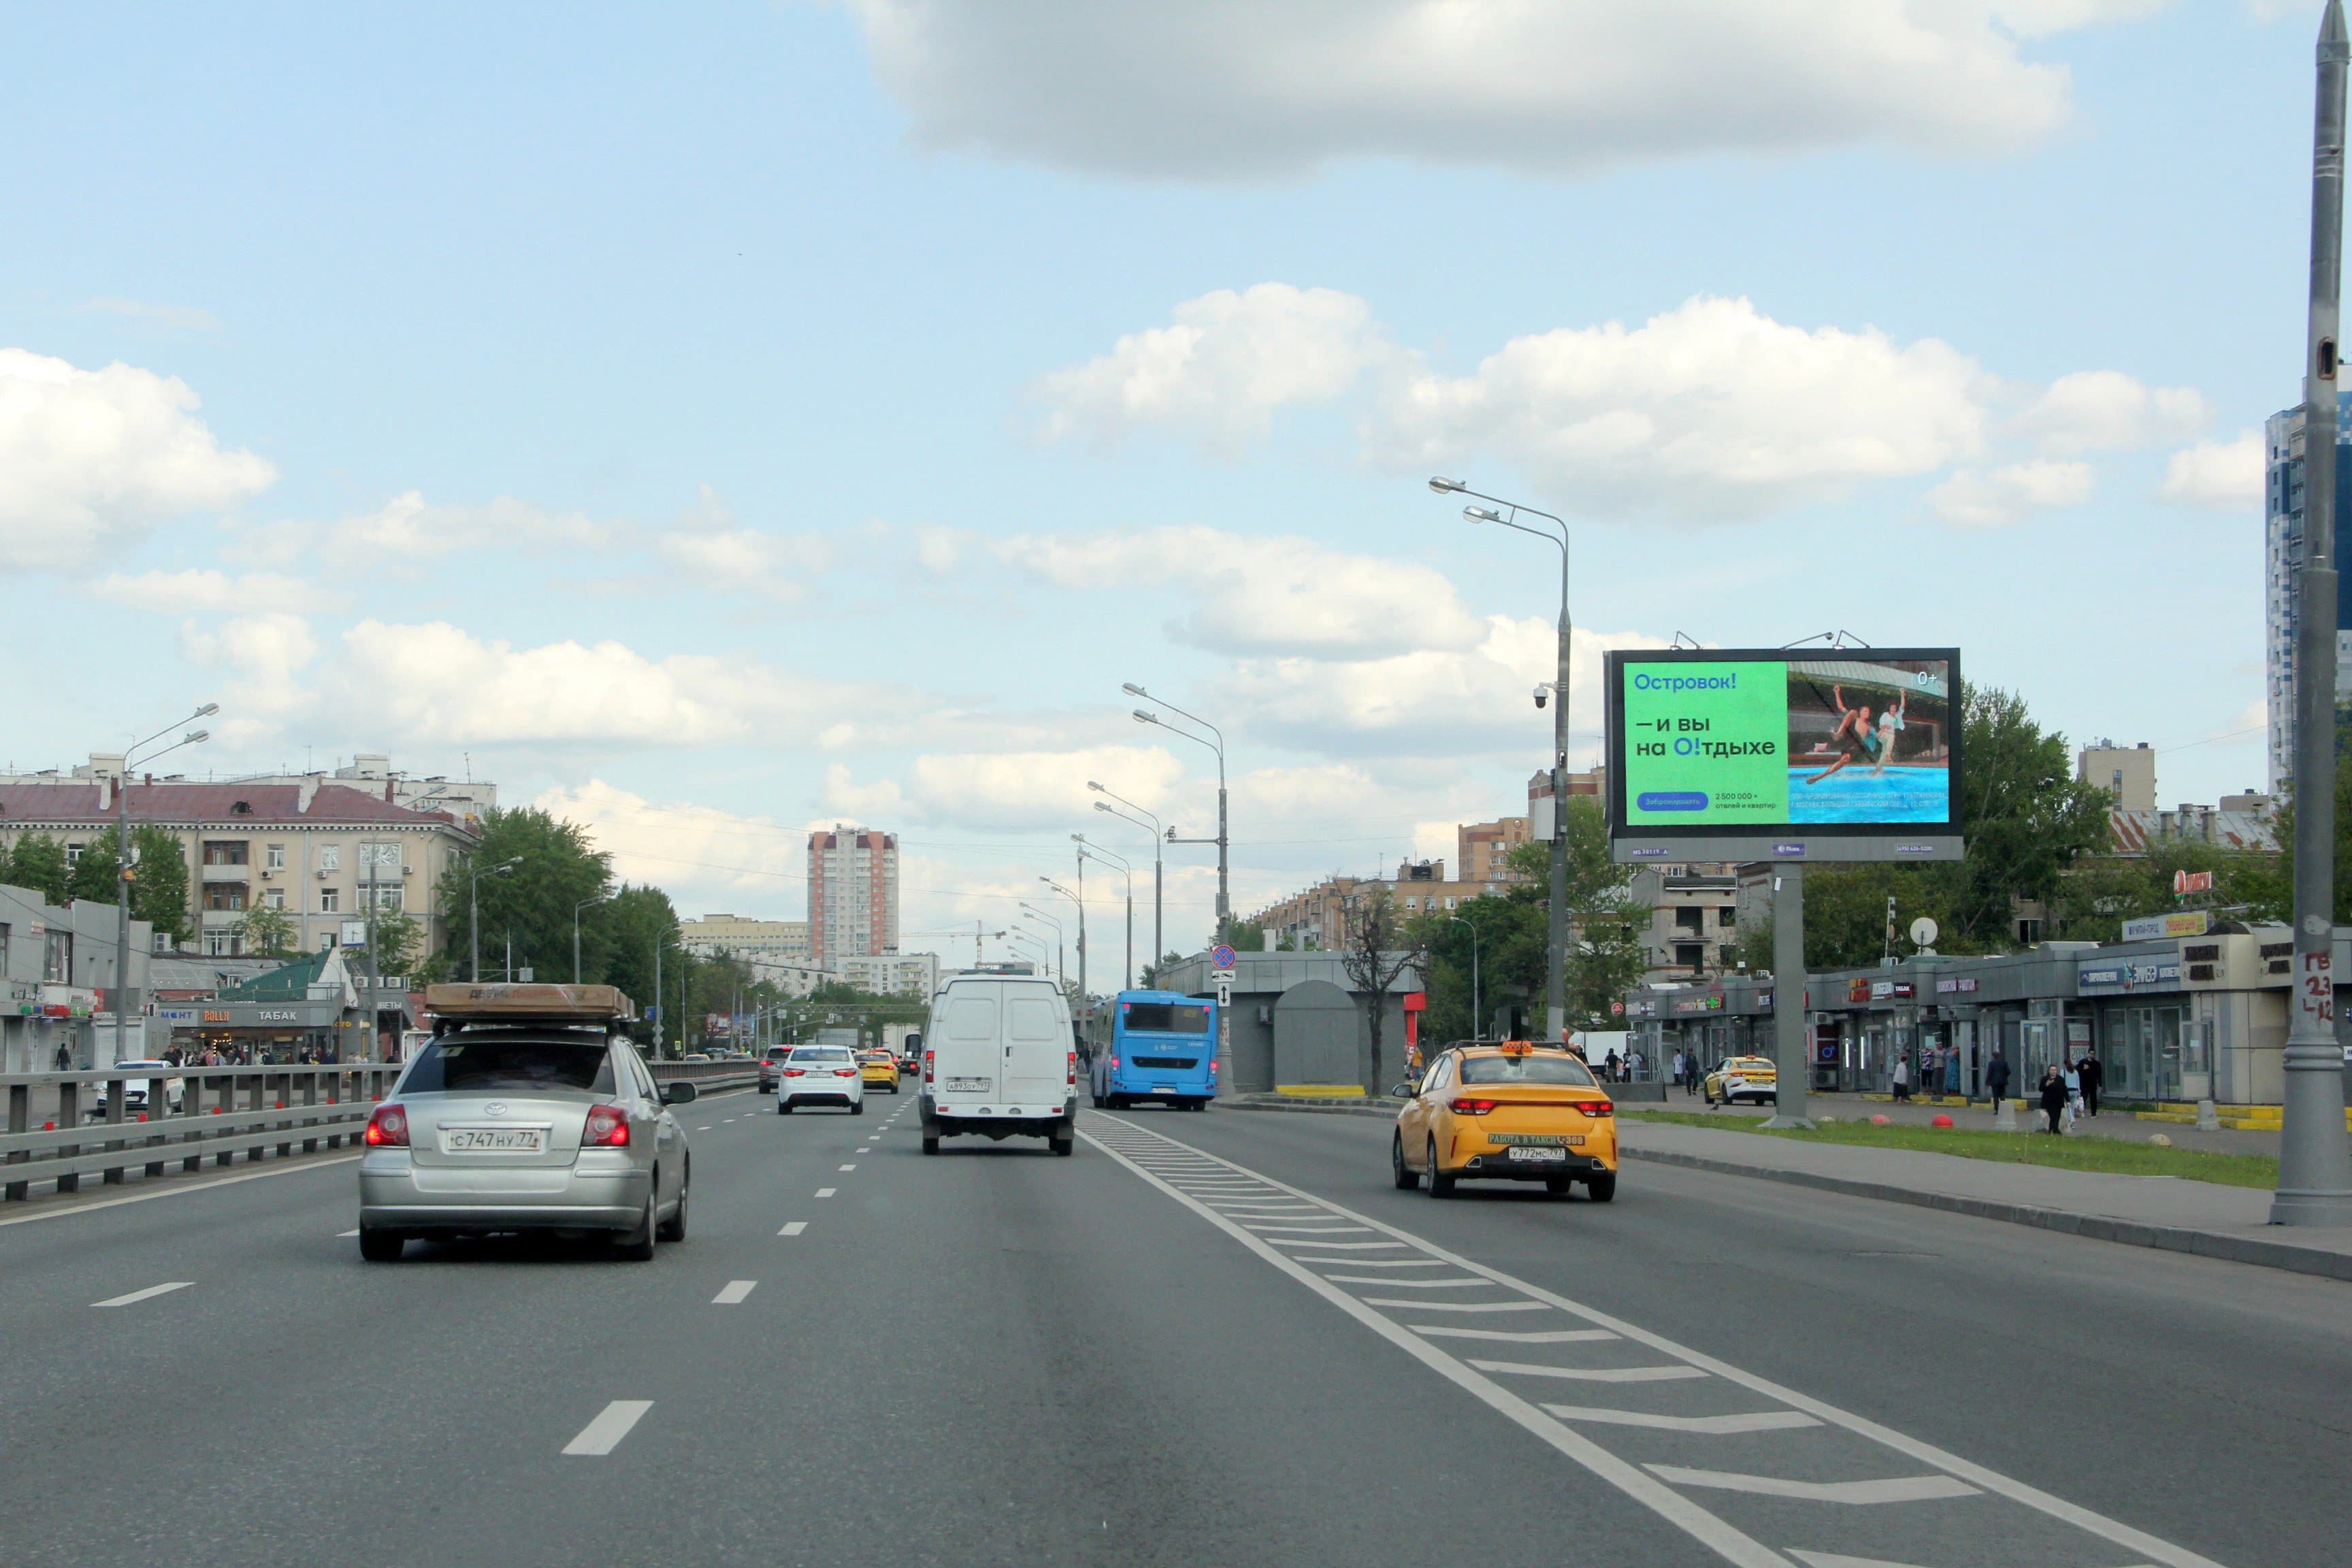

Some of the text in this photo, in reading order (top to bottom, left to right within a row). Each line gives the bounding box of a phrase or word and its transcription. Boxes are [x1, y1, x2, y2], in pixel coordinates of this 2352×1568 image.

[1634, 673, 1736, 693] Островок!
[1918, 672, 1938, 685] 0+
[1678, 718, 1710, 732] вы
[1636, 737, 1776, 758] на О!тдыхе
[259, 1011, 297, 1020] ТАБАК
[1489, 1134, 1520, 1143] РАБОТА
[1531, 1135, 1556, 1144] ТАКСИ
[1566, 1136, 1583, 1145] 369
